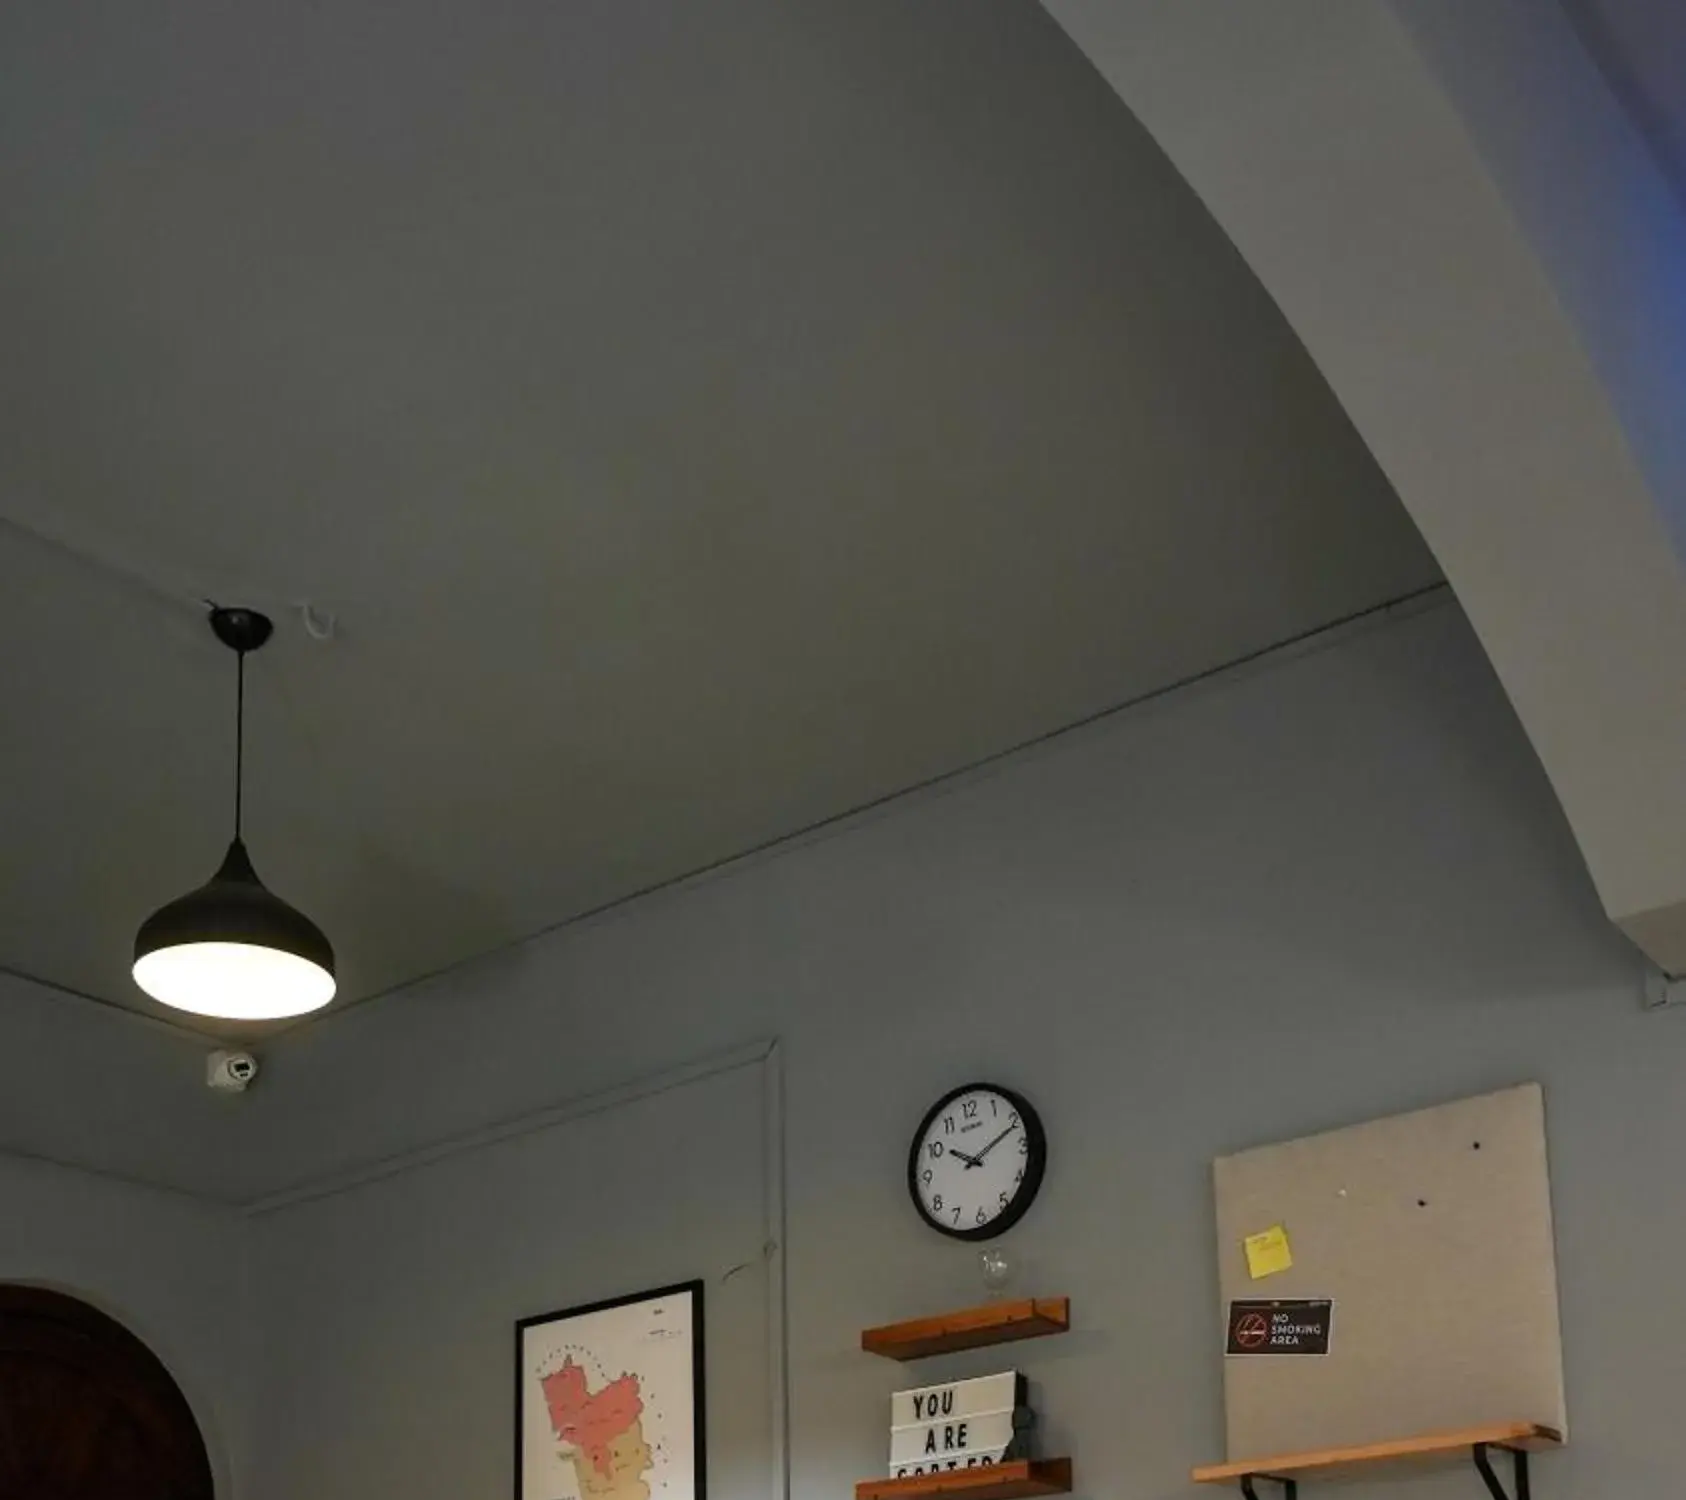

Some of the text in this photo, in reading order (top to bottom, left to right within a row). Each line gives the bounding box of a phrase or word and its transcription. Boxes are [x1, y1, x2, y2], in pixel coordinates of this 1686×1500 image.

[961, 1100, 977, 1119] 12
[990, 1099, 998, 1118] 1
[944, 1116, 955, 1135] 11
[1008, 1111, 1020, 1129] 2
[927, 1141, 944, 1159] 10
[1018, 1137, 1029, 1155] 3
[922, 1169, 933, 1186] 9
[932, 1194, 943, 1212] 8
[999, 1191, 1009, 1209] 5
[951, 1207, 961, 1225] 7
[975, 1206, 987, 1224] 6
[1273, 1313, 1289, 1323] NO
[1270, 1323, 1321, 1335] SMOKING
[1270, 1335, 1300, 1345] AREA
[913, 1390, 953, 1419] YOU
[925, 1423, 967, 1454] ARE
